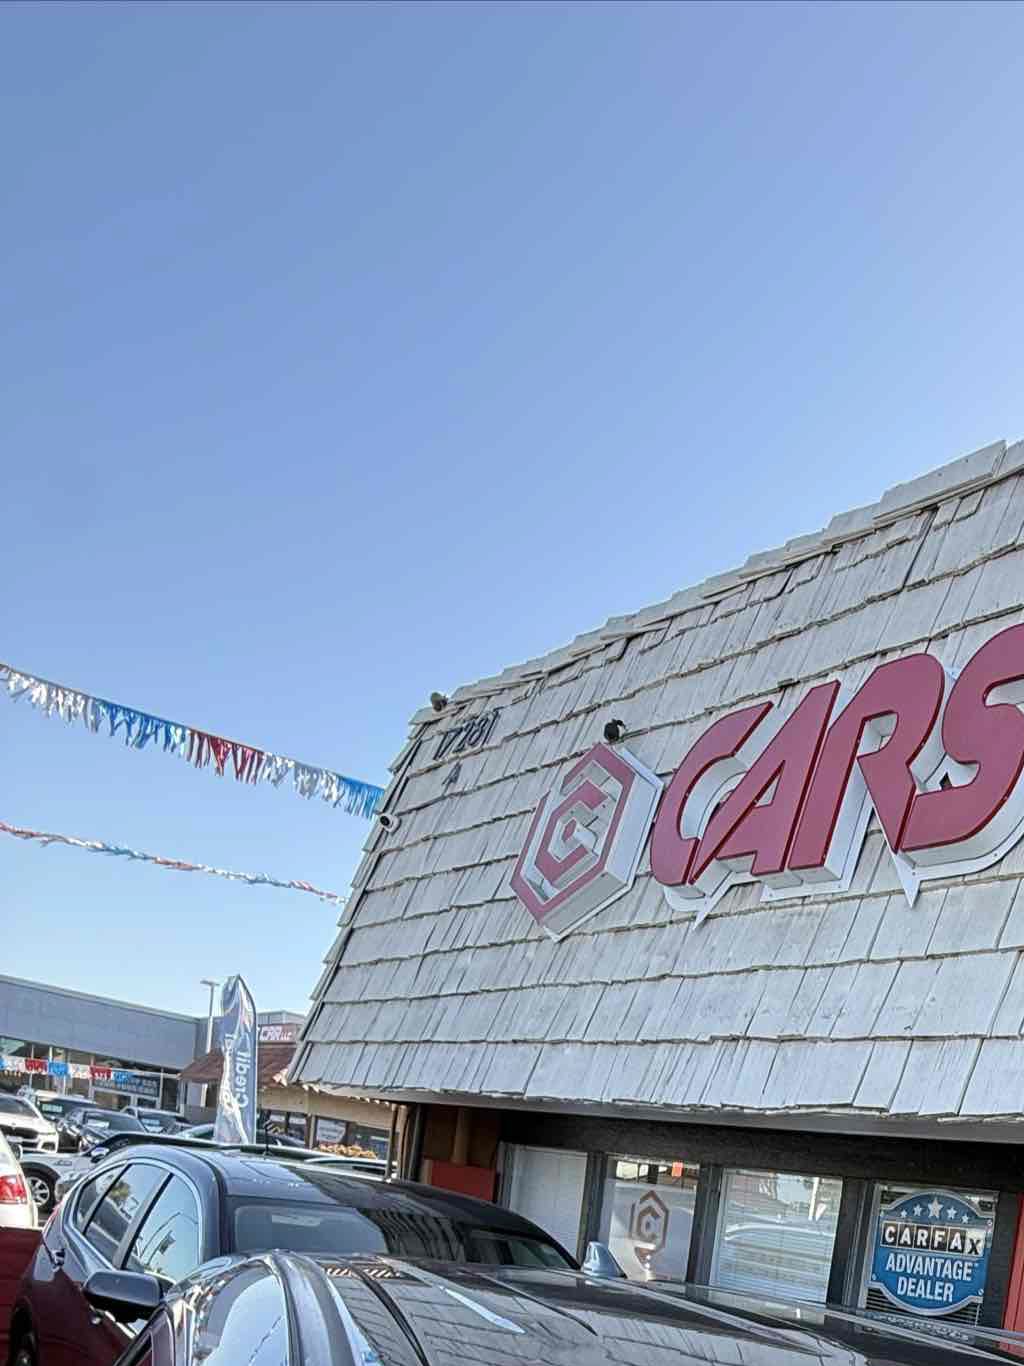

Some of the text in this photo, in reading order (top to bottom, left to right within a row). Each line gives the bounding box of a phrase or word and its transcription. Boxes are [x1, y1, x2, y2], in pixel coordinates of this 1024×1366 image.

[433, 710, 498, 760] 17281
[884, 1225, 982, 1256] CARFAX
[885, 1252, 973, 1282] ADVANTAGE
[896, 1276, 955, 1302] DEALER
